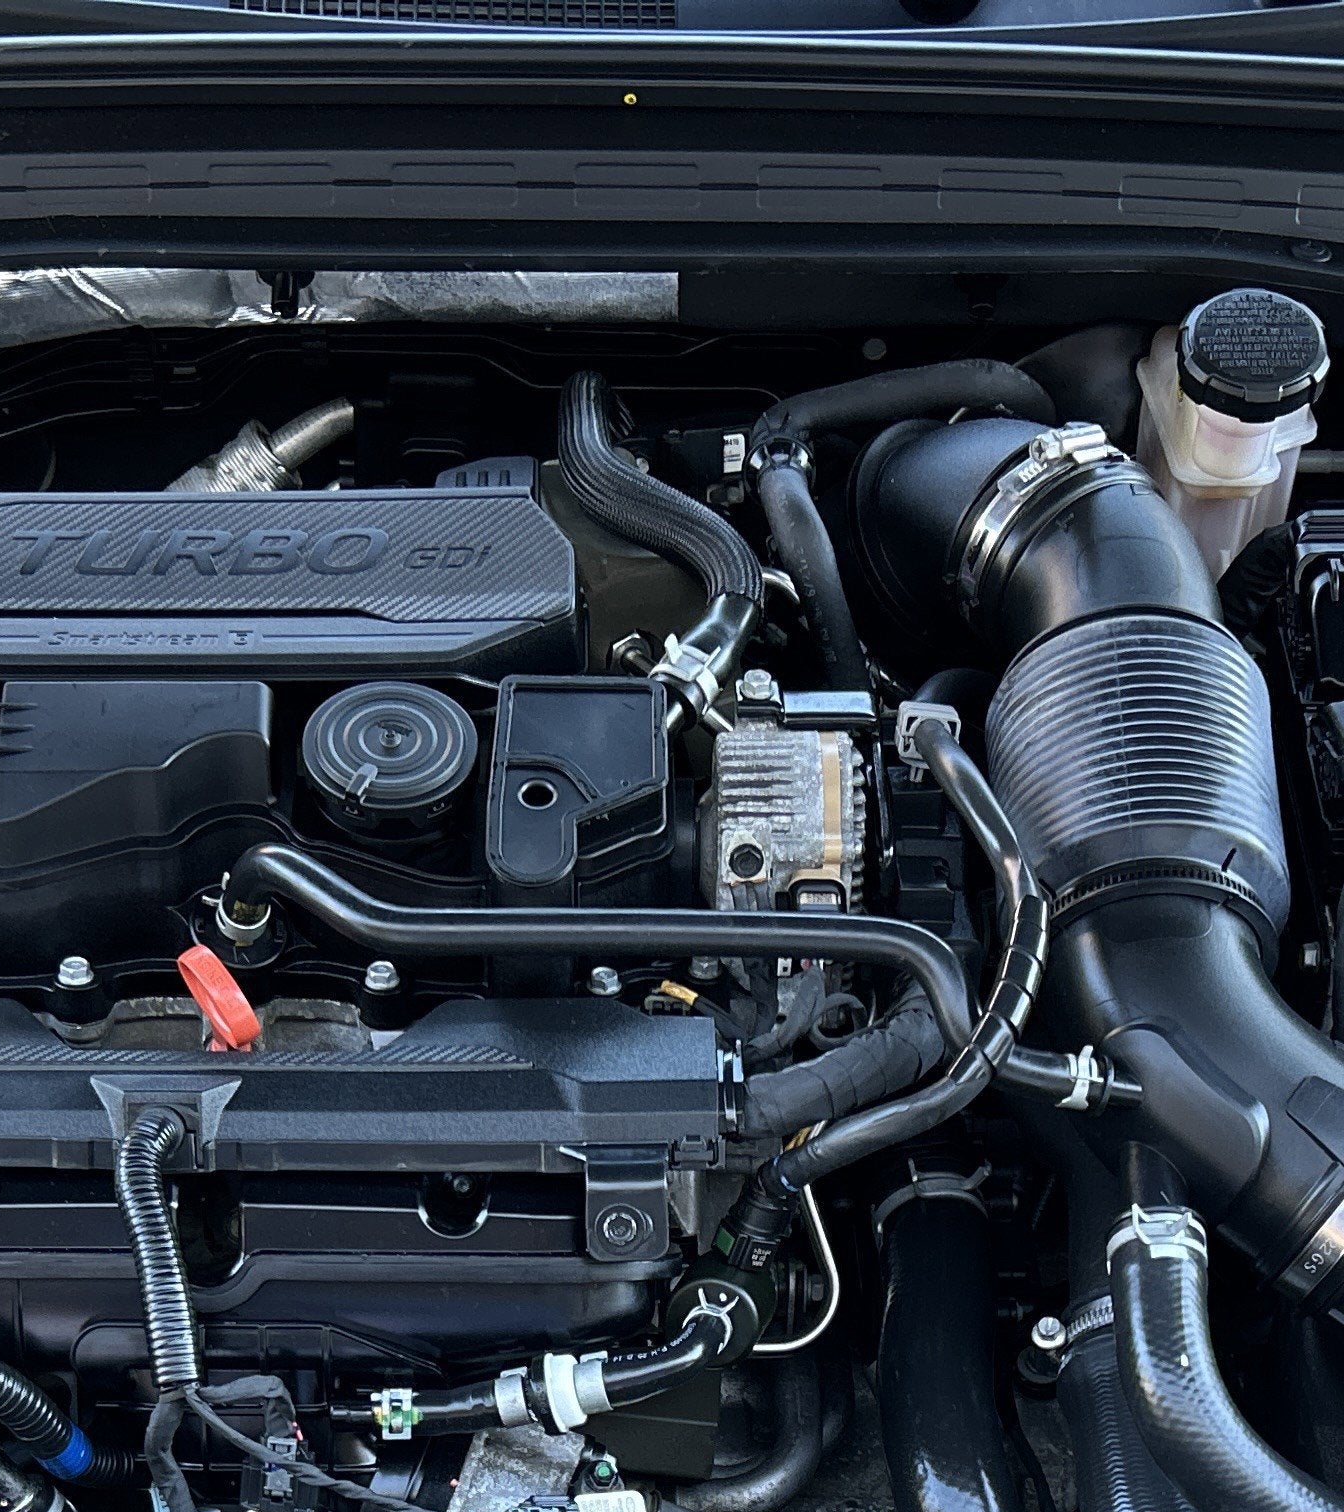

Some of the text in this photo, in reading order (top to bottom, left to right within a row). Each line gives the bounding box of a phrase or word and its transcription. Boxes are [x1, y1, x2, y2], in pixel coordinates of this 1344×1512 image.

[13, 527, 492, 576] TURBO GDi
[48, 630, 219, 646] Smartstream
